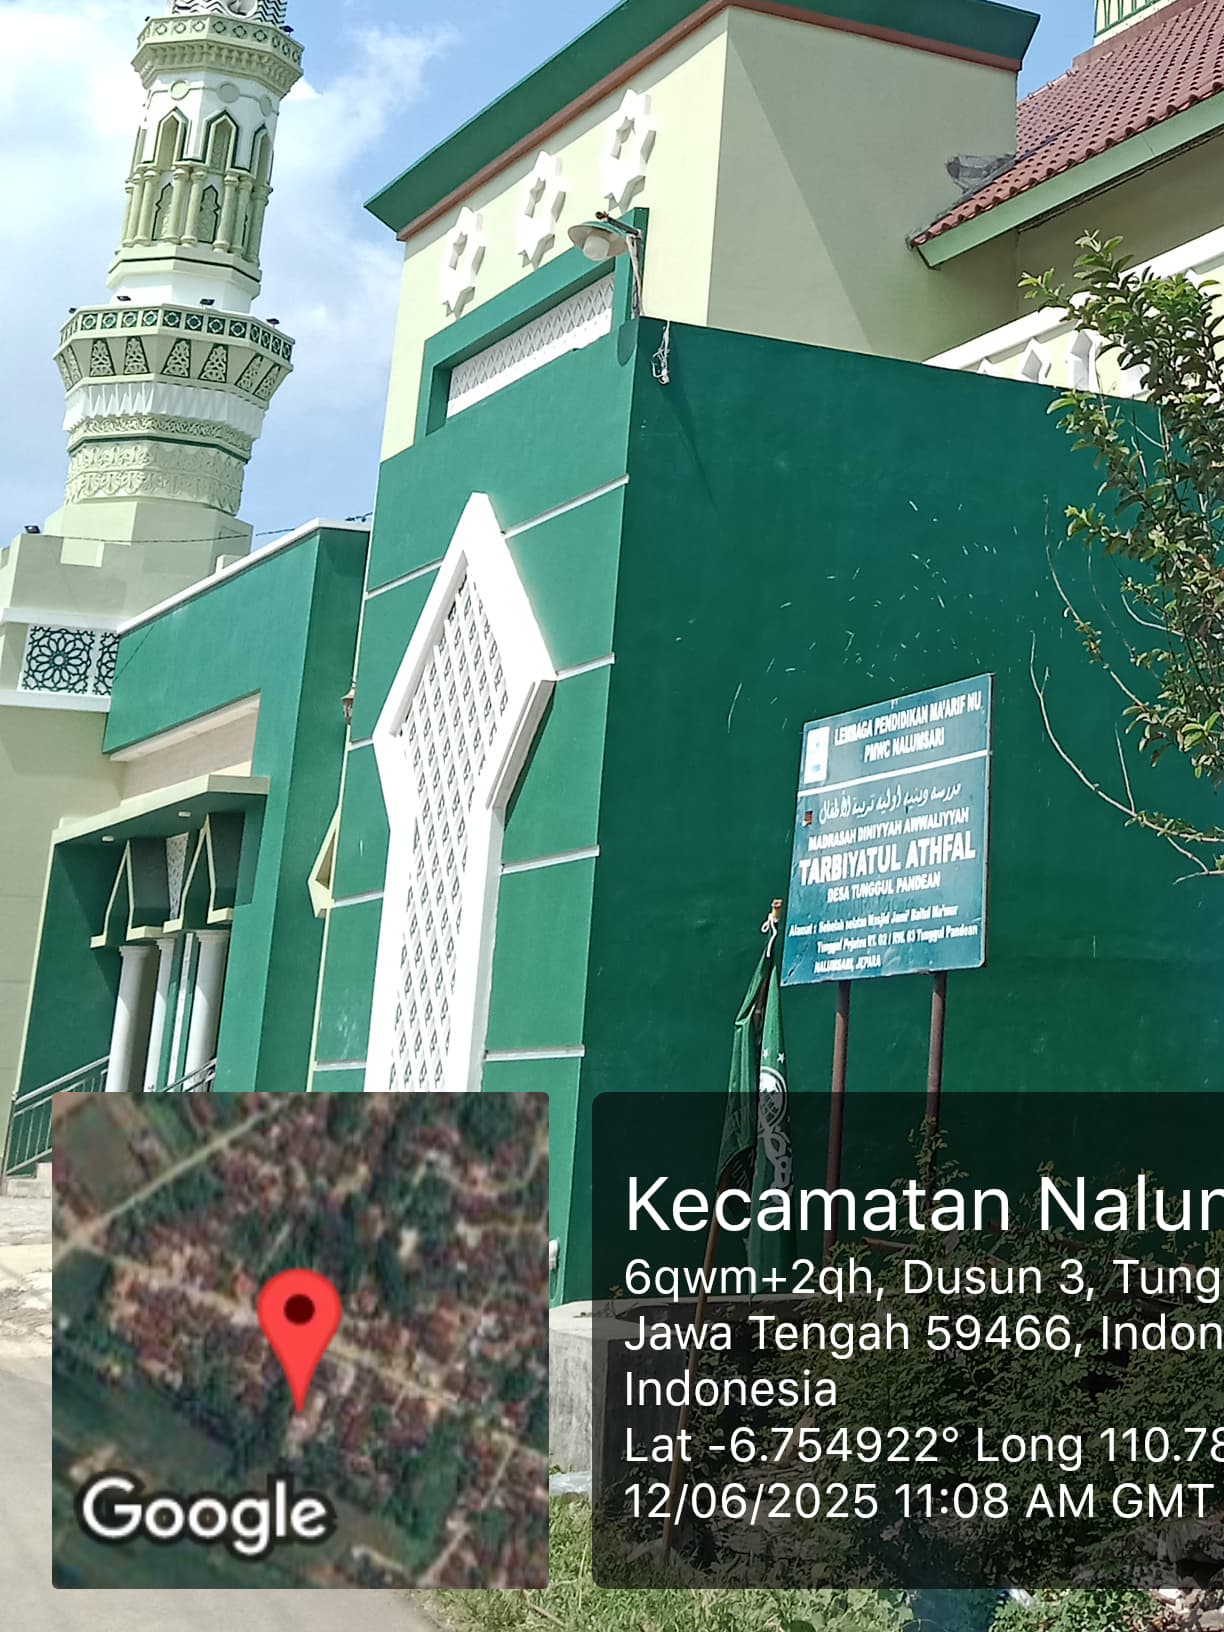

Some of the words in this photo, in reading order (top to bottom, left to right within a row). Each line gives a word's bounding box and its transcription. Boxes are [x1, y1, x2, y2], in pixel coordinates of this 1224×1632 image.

[835, 720, 872, 746] LEMBAGA
[874, 706, 928, 735] PENDIDIKAN
[930, 696, 965, 722] MA'ARIF
[968, 691, 982, 712] NU
[892, 727, 945, 757] NALUMSARI
[808, 828, 856, 851] MADRASAH
[857, 819, 901, 842] DINIYYAH
[903, 807, 969, 833] AWWALIYYAH
[799, 844, 902, 886] TARBIYATUL
[905, 830, 976, 868] ATHFAL
[827, 885, 850, 903] DESA
[851, 879, 894, 899] TUNGGUL
[896, 871, 941, 894] PANDEAN
[917, 927, 945, 943] Tunggul
[946, 924, 978, 938] Pandean
